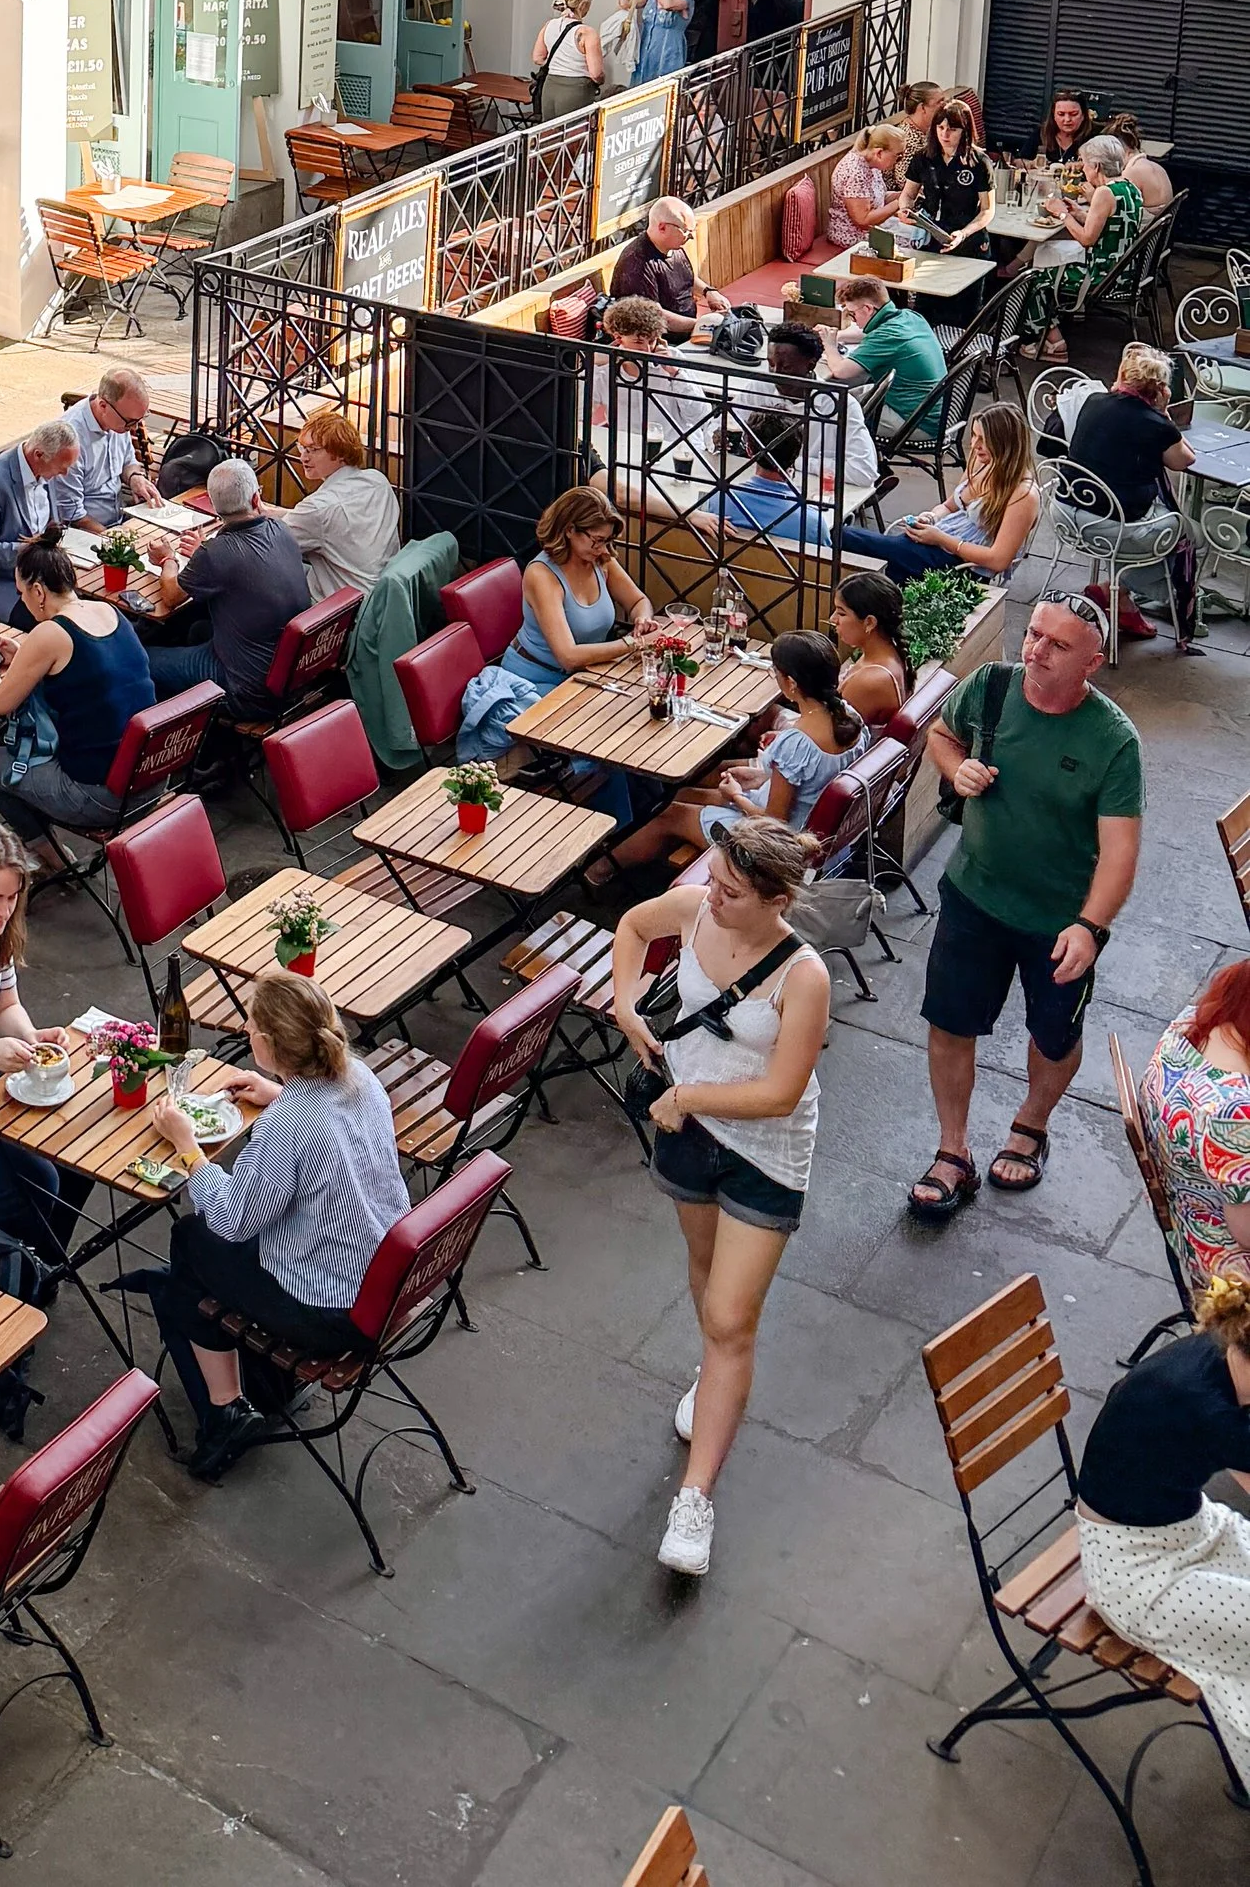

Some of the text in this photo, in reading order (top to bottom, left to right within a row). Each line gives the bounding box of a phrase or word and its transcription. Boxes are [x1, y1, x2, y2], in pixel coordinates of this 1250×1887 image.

[807, 46, 828, 68] GREAT
[603, 113, 665, 161] FISH CHIPS
[348, 220, 388, 262] REAL
[388, 199, 427, 244] ALES
[386, 255, 426, 295] BEERS
